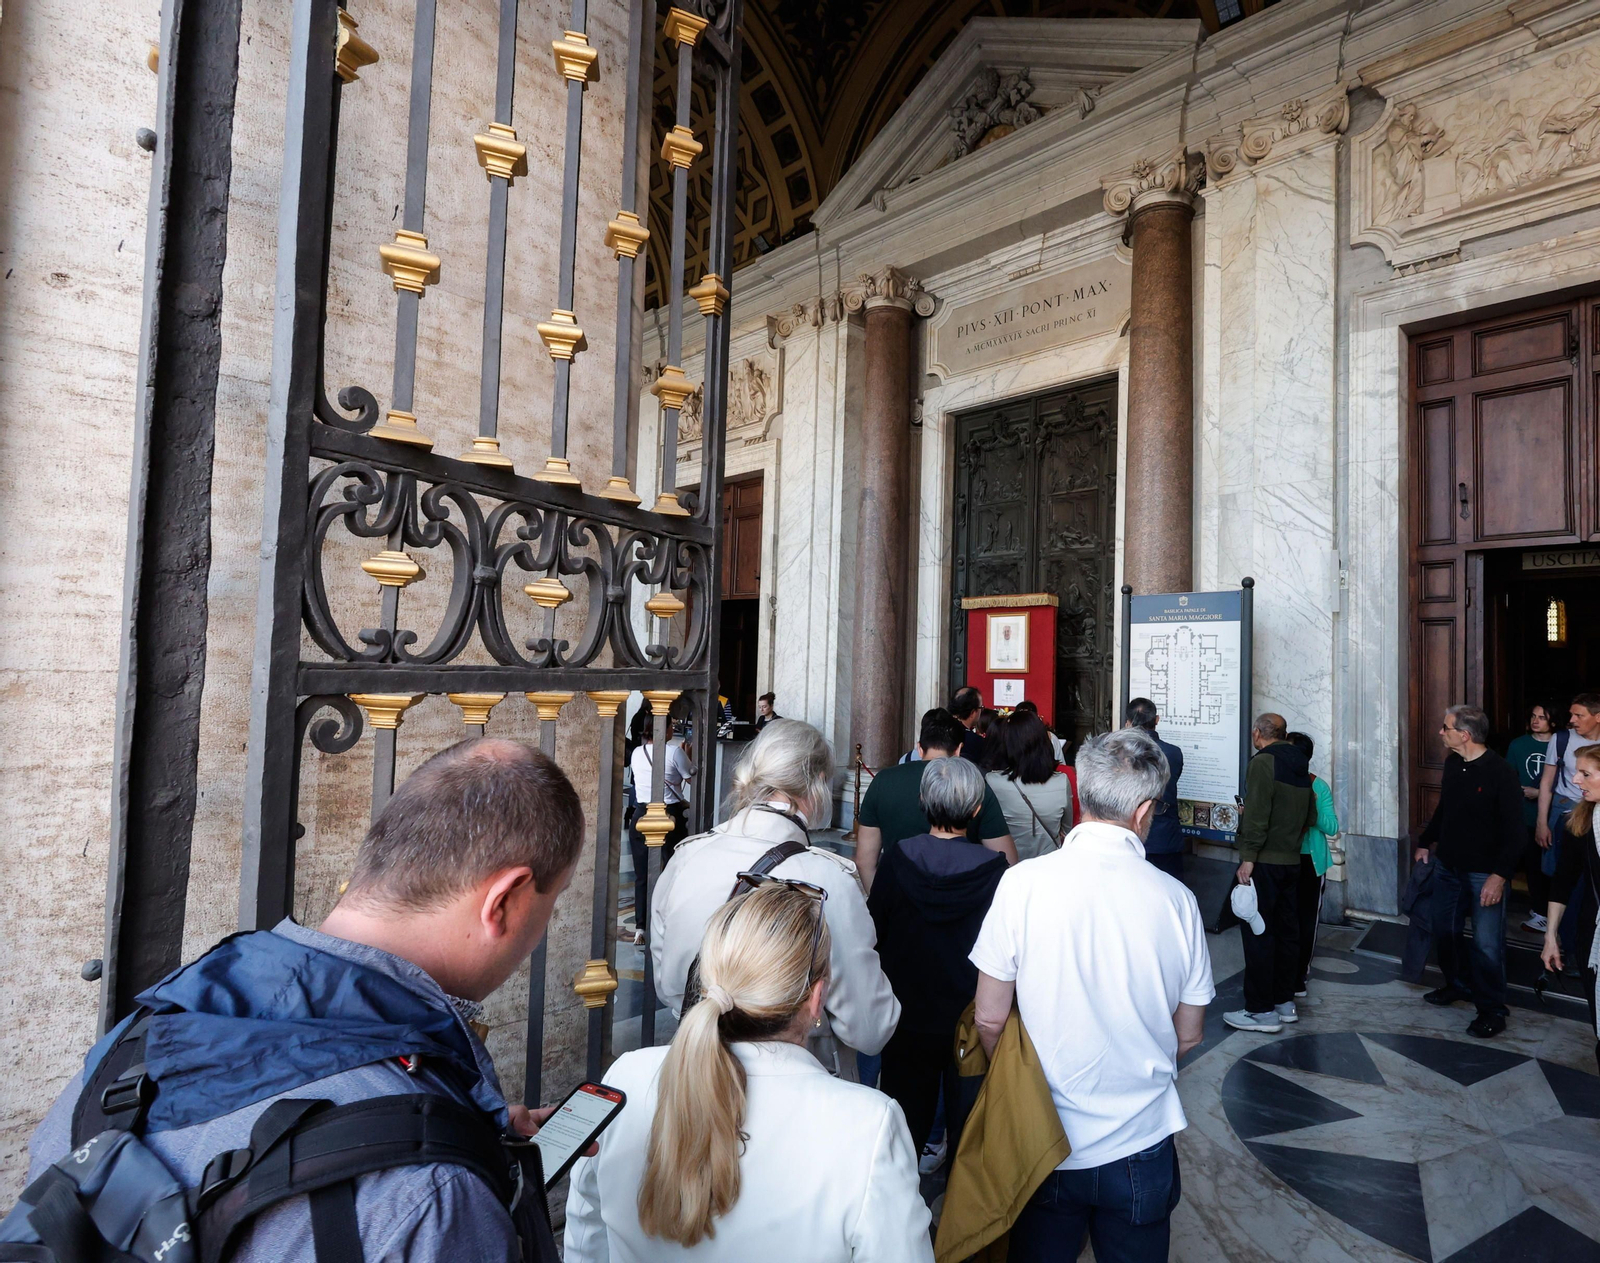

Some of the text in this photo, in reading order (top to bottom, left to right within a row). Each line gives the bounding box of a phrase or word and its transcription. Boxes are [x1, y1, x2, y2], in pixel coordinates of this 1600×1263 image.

[1026, 323, 1050, 337] SACRI
[1054, 313, 1084, 329] PRINC
[1531, 551, 1600, 567] USCITA
